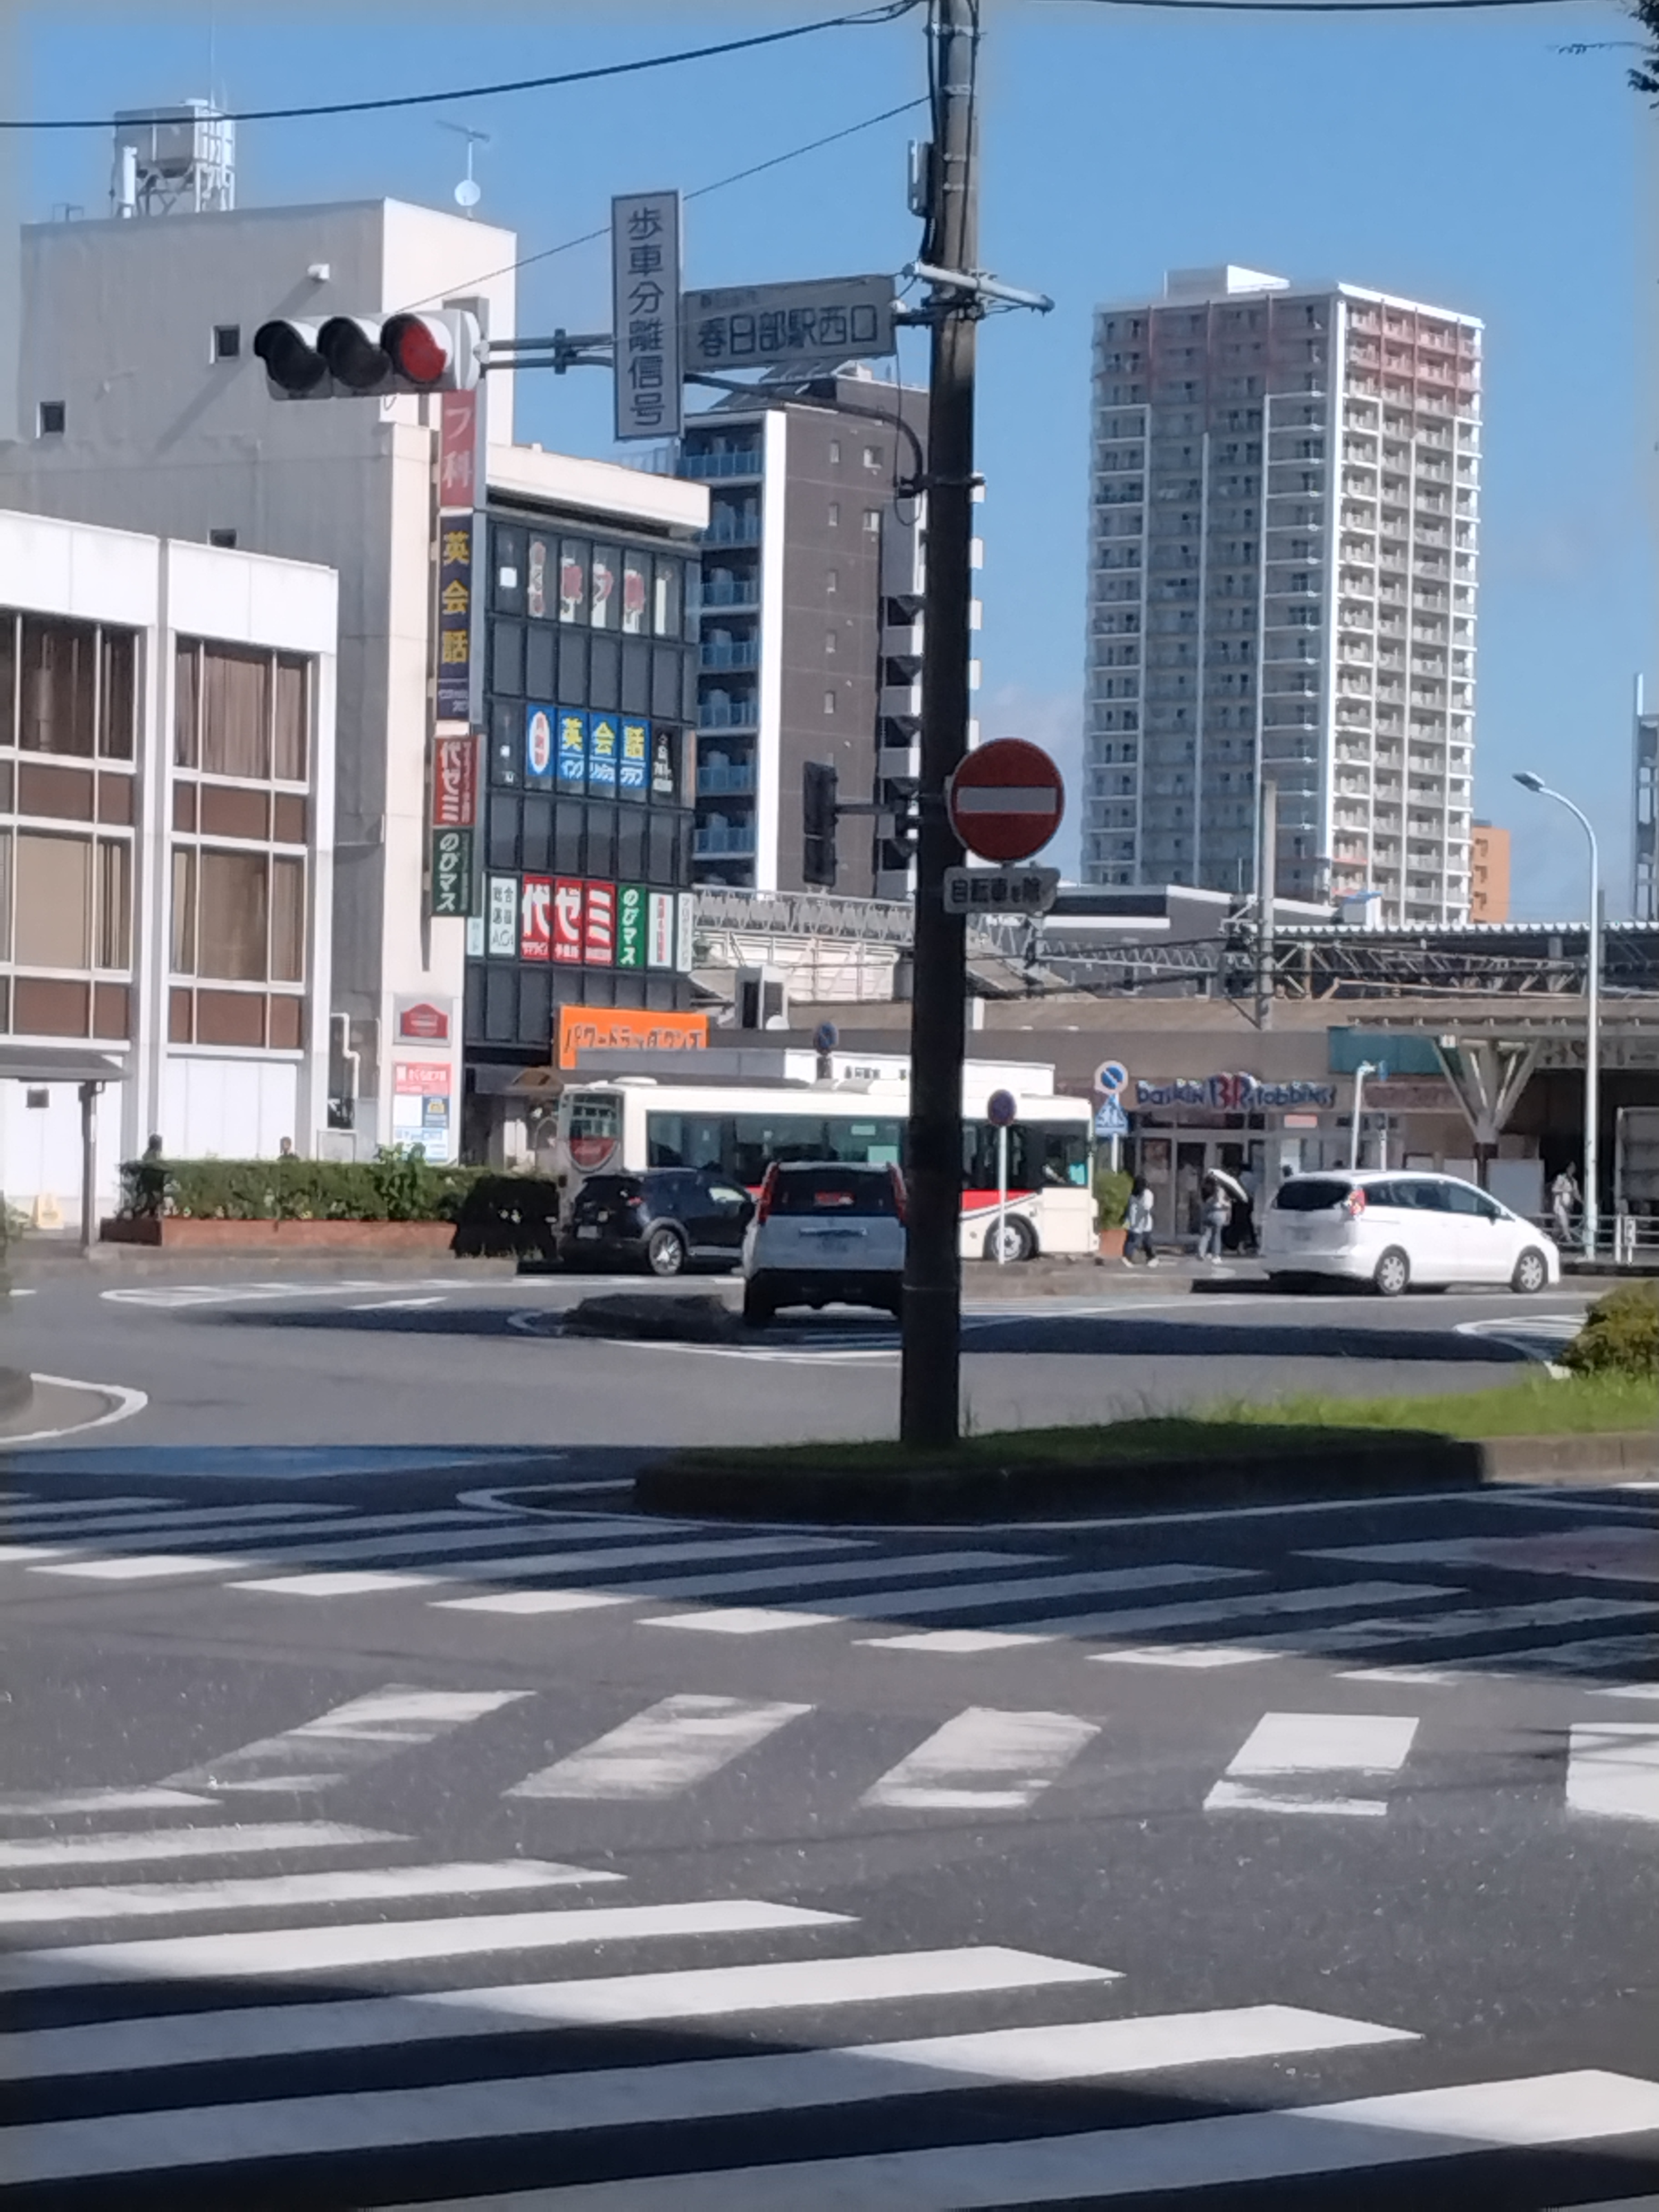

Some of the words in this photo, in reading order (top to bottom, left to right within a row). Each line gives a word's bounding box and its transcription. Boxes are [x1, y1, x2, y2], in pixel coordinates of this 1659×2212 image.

[627, 207, 665, 426] 歩車分離信号
[698, 304, 878, 357] 春日部駅西口
[442, 531, 469, 663] 英会話
[562, 716, 645, 759] 英会話
[522, 883, 611, 943] 代ゼミ
[621, 889, 640, 965] のびマス
